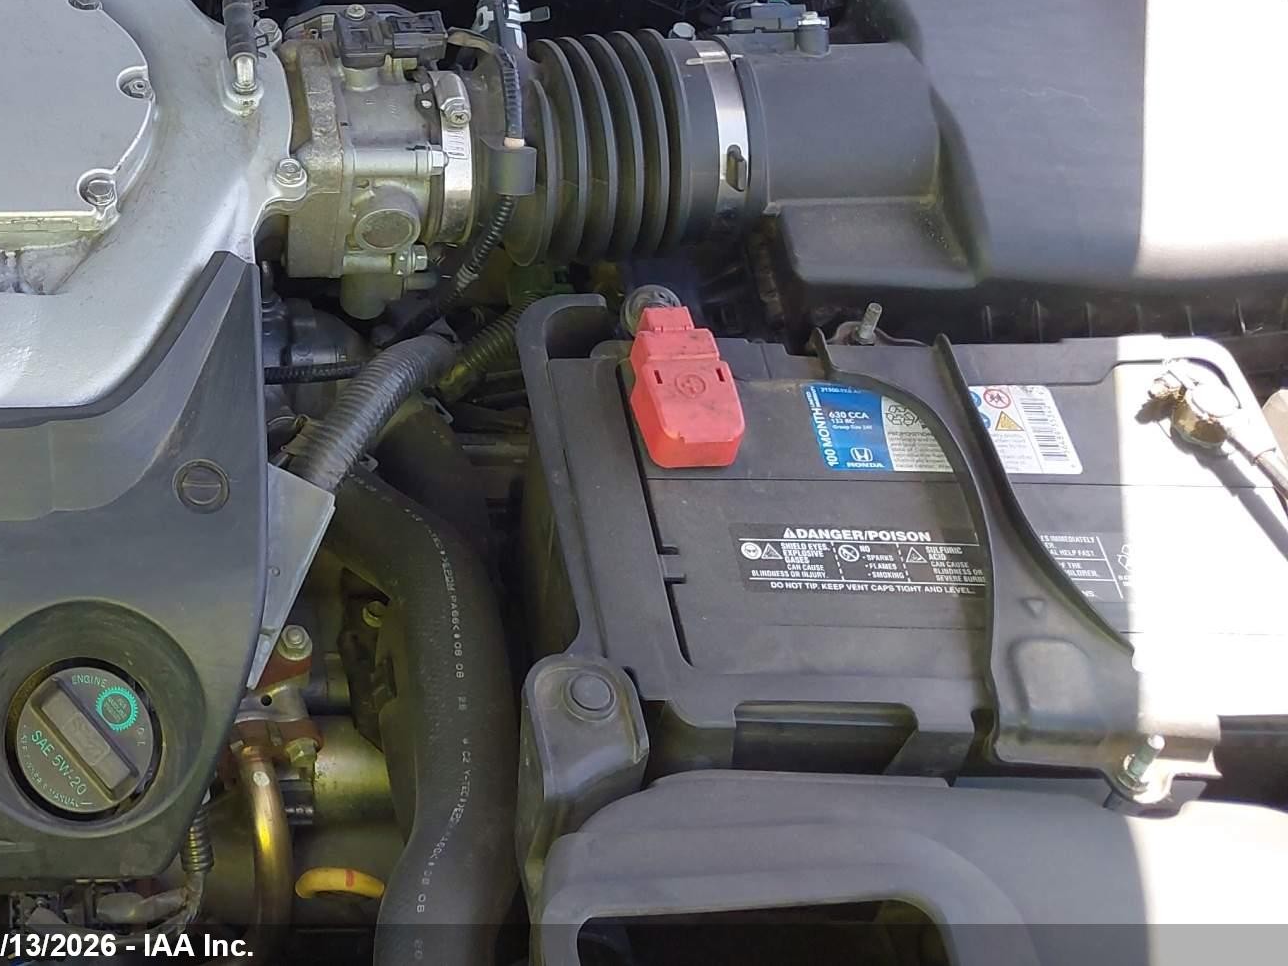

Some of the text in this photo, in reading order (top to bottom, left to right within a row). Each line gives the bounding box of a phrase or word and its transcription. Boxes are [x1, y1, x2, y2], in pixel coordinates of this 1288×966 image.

[829, 411, 869, 420] 630 CCA
[811, 408, 839, 467] 100 MONTH
[795, 529, 931, 542] DANGER/POISON
[781, 542, 807, 550] SHIELD
[859, 545, 870, 553] NO
[925, 546, 963, 554] SULFURIC
[782, 550, 824, 558] EXPLOSIVE
[784, 556, 810, 564] GASES
[802, 563, 824, 571] CAUSE
[872, 571, 905, 579] SMOKING
[870, 584, 895, 592] CAPS
[924, 585, 943, 593] AND
[71, 674, 109, 688] ENGINE
[31, 730, 55, 757] SAE
[51, 754, 88, 795] 5W-20
